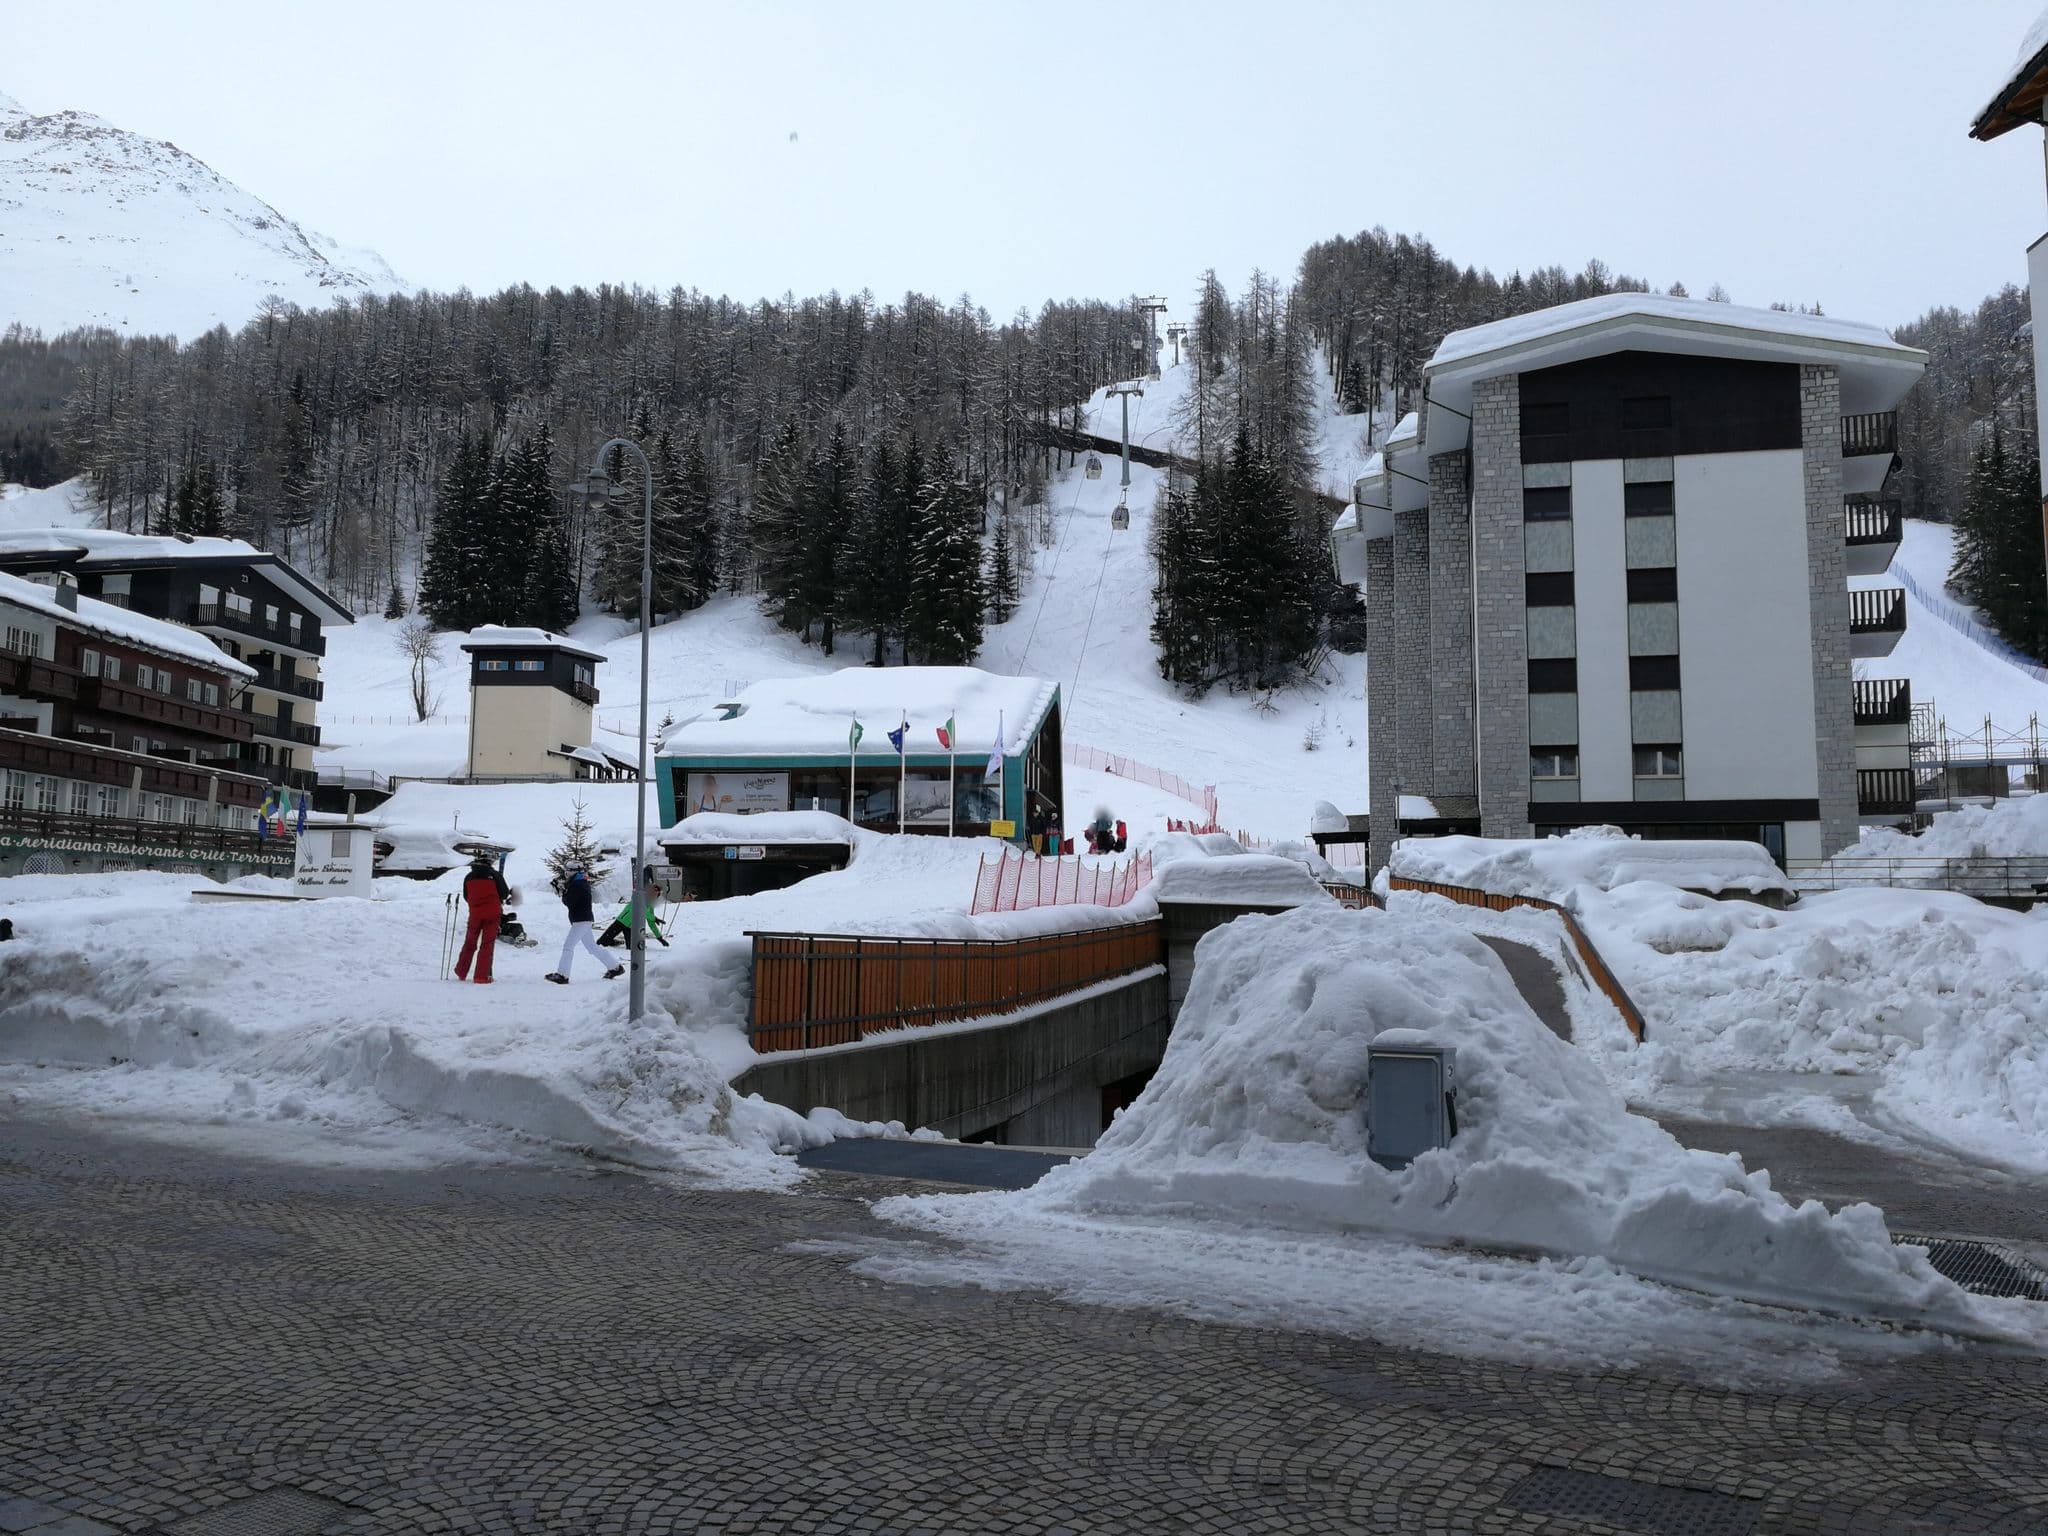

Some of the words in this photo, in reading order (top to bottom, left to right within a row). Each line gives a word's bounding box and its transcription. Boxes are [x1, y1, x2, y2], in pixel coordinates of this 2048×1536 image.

[16, 837, 101, 852] Meridiana
[106, 842, 185, 857] Ristorante
[190, 849, 226, 861] Grill
